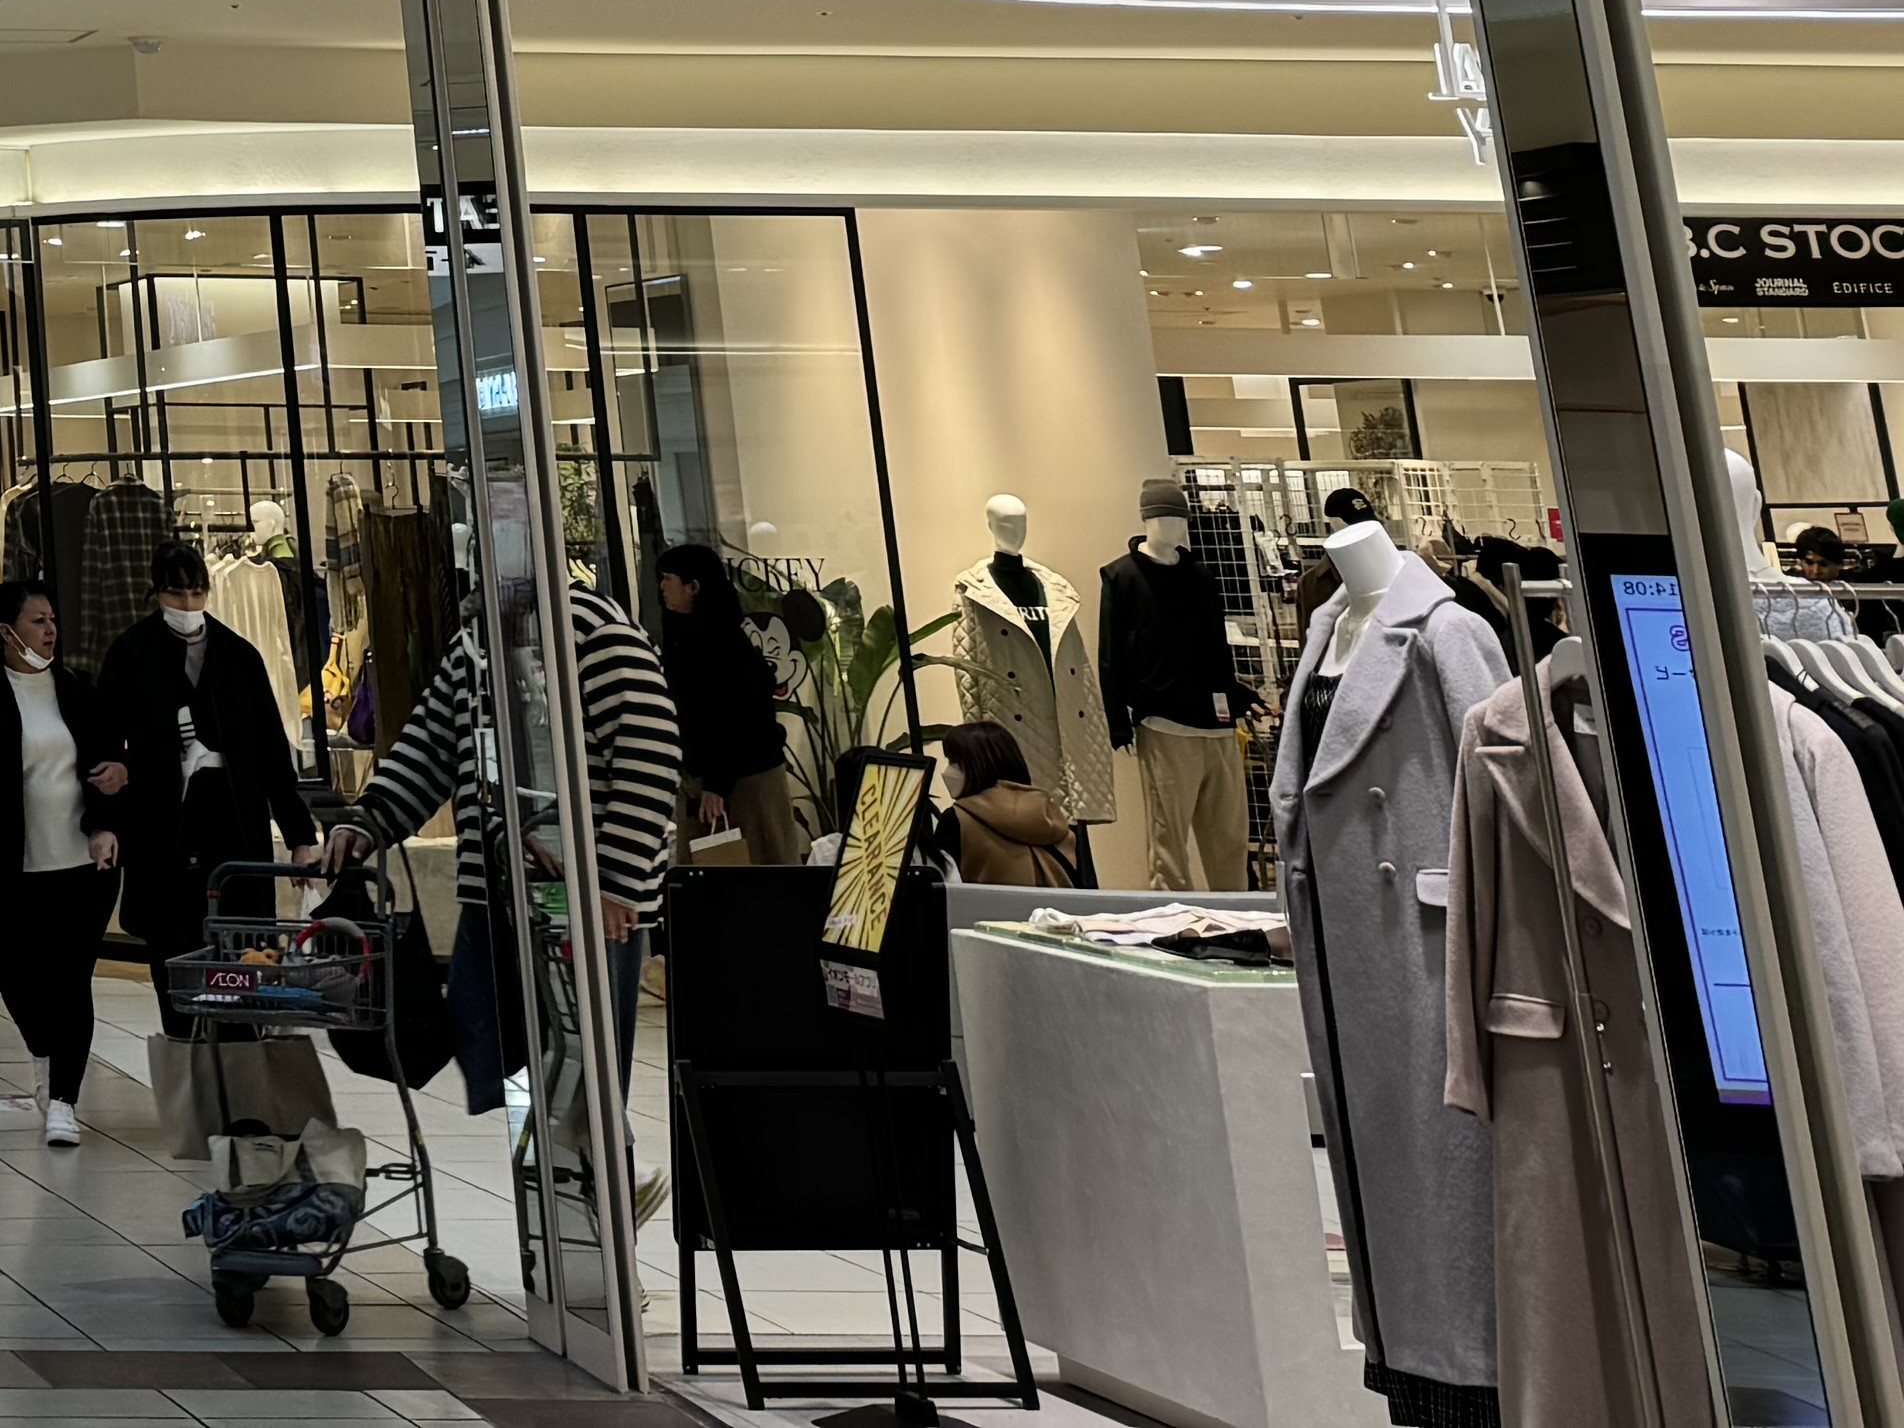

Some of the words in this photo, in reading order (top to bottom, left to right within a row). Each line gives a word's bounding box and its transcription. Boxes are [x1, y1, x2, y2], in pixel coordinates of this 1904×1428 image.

[1760, 223, 1904, 260] STOC
[1755, 277, 1808, 288] JOURNAL
[1756, 287, 1809, 296] STANDARD
[1833, 281, 1893, 294] EDIFICE
[726, 557, 824, 594] ICKEY
[859, 781, 889, 931] CLEARANCE
